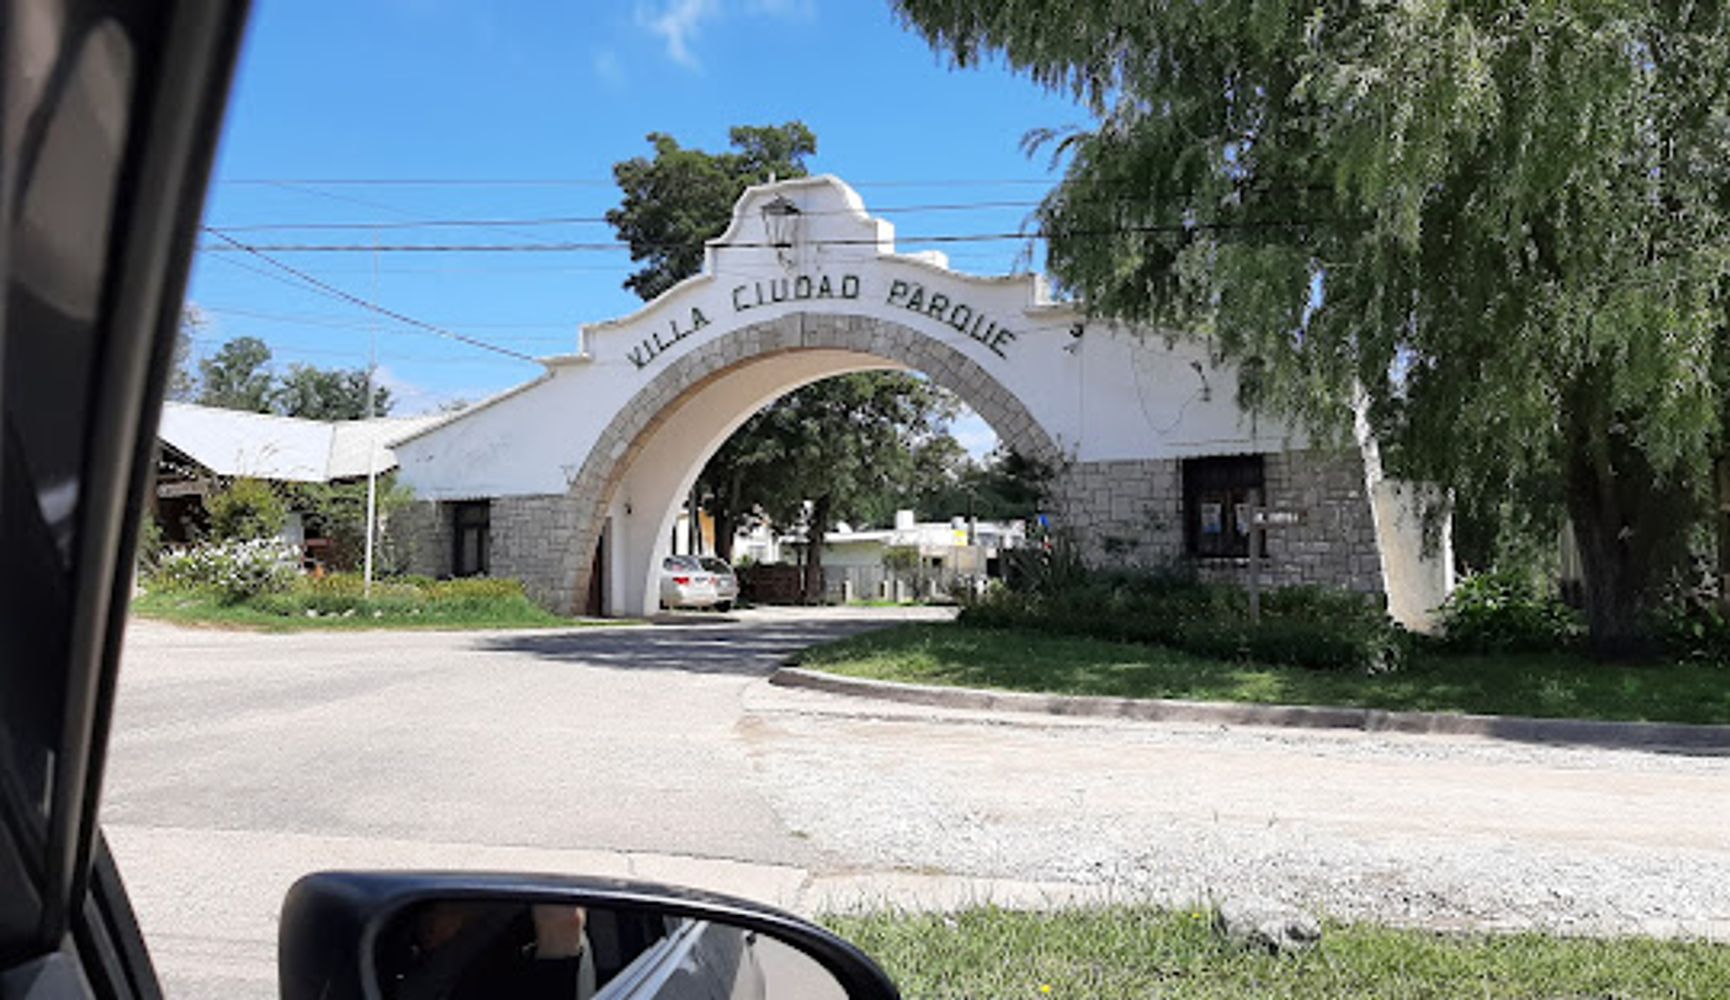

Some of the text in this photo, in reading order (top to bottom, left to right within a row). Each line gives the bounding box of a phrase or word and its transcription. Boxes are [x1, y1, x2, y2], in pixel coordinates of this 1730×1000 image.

[626, 275, 1017, 370] VILLA CIUDAD PARQUE
